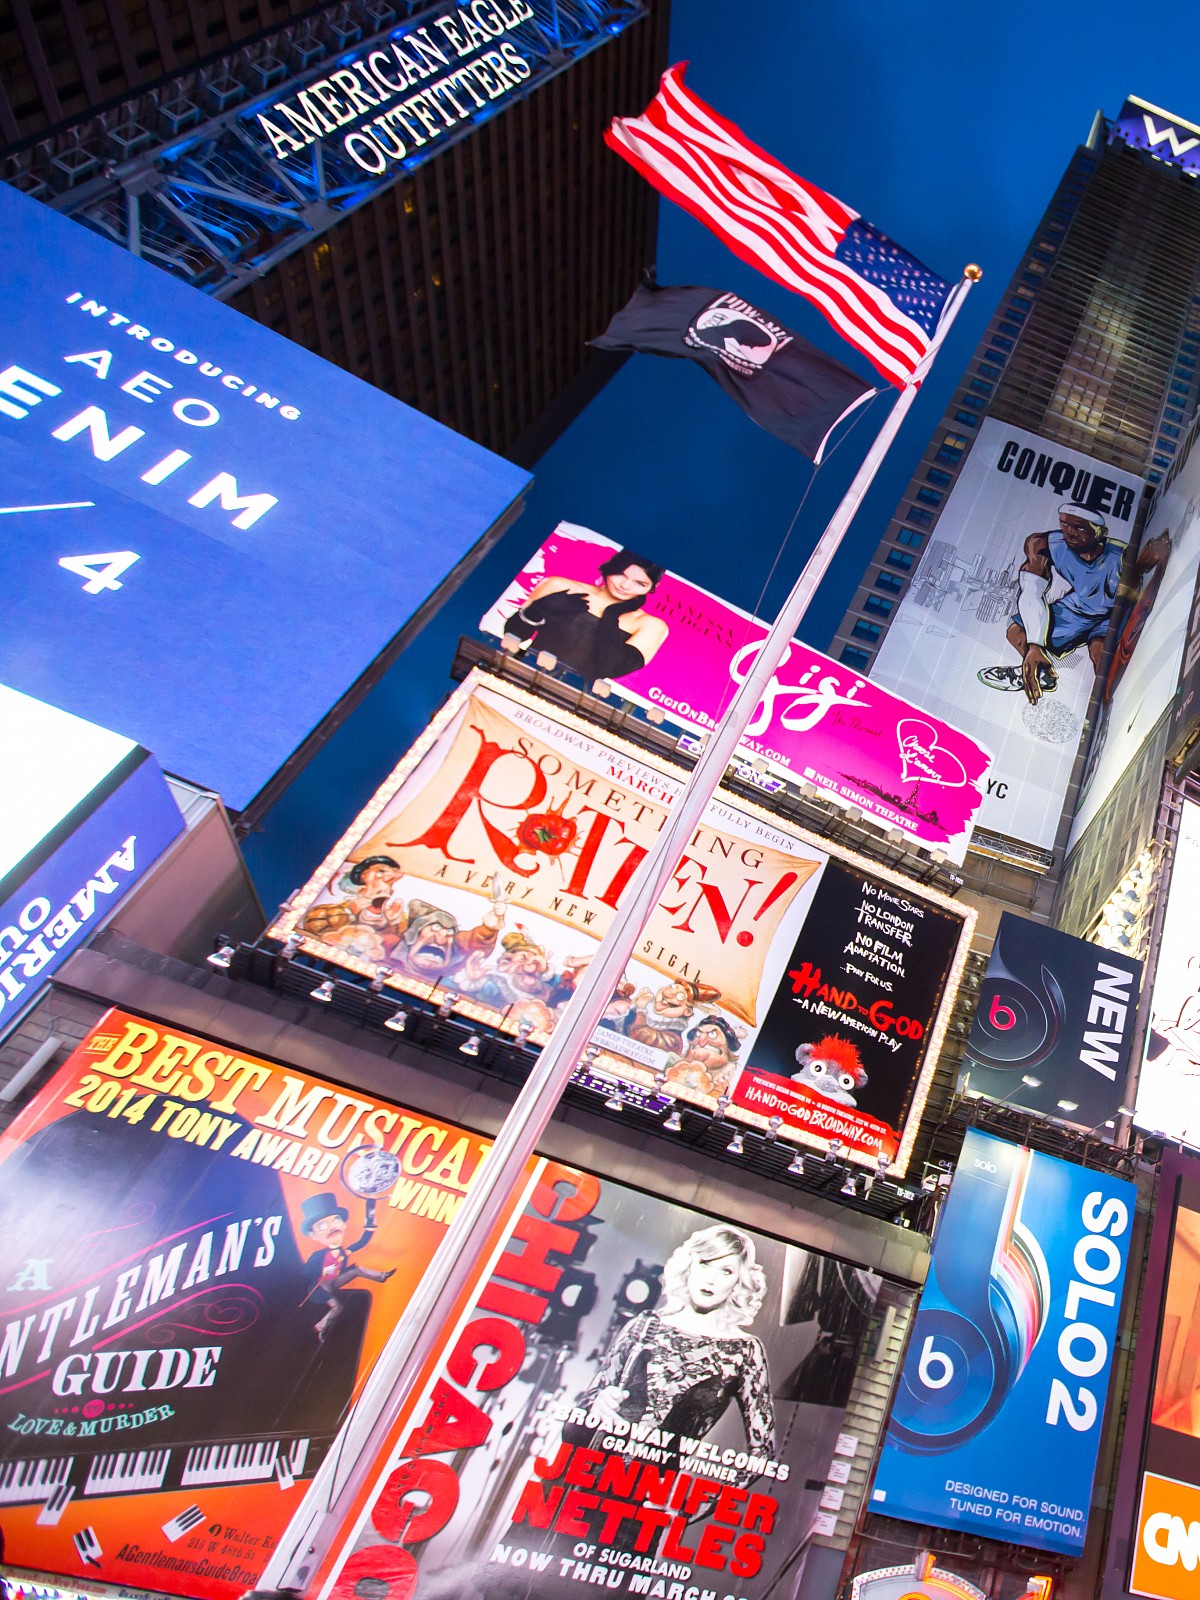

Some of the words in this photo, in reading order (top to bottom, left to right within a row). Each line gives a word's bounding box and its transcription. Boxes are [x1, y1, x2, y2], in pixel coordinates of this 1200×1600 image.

[256, 28, 449, 160] AMERICAN
[434, 0, 534, 57] EAGLE
[345, 42, 531, 174] OUTFITTERS
[1142, 113, 1200, 157] W
[66, 292, 301, 421] INTRODUCING
[64, 348, 221, 427] AEO
[0, 365, 279, 530] ENIM
[996, 439, 1136, 522] CONQUER
[58, 550, 141, 594] 4
[511, 737, 765, 869] SOMETING
[513, 710, 595, 753] BROADWAY
[598, 750, 670, 789] PREVIEWS
[755, 826, 796, 851] BEGIN
[605, 765, 675, 805] MARCH
[814, 772, 839, 793] NEIL
[839, 784, 873, 810] SIMON
[875, 801, 919, 831] THEATRE
[434, 864, 448, 878] A
[548, 896, 599, 926] NEW
[861, 899, 876, 914] NO
[875, 907, 915, 933] LONDON
[855, 931, 873, 948] NO
[873, 940, 904, 965] FILM
[788, 961, 858, 1010] HAND
[868, 1000, 924, 1040] GOD
[809, 1000, 842, 1021] NEW
[839, 1013, 878, 1039] AMERICAN
[877, 1031, 903, 1053] PLAY
[1079, 961, 1134, 1082] NEW
[86, 1035, 117, 1053] THE
[90, 1021, 273, 1115] BEST
[64, 1075, 157, 1126] 2014
[150, 1100, 243, 1151] TONY
[230, 1128, 341, 1185] AWARD
[388, 1176, 465, 1227] WINN
[974, 1156, 998, 1174] solo
[6, 1257, 54, 1292] A
[51, 1346, 223, 1397] GUIDE
[330, 1160, 600, 1600] CHICAGO
[554, 1406, 674, 1449] BROADWAY
[677, 1435, 791, 1482] WELCOMES
[678, 1456, 738, 1483] WINNER
[533, 1442, 779, 1535] JENNIFER
[945, 1480, 1009, 1504] DESIGNED
[1011, 1496, 1038, 1511] FOR
[1040, 1502, 1085, 1523] SOUND.
[950, 1498, 992, 1518] TUNED
[995, 1509, 1022, 1524] FOR
[1024, 1516, 1083, 1538] EMOTION.
[511, 1480, 765, 1579] NETTLES
[115, 1543, 261, 1586] AGentlemansGuideBroa
[490, 1543, 554, 1573] NOW
[558, 1558, 626, 1591] THRU
[628, 1573, 717, 1600] MARCH
[573, 1542, 597, 1558] OF
[598, 1546, 692, 1581] SUGARLAND
